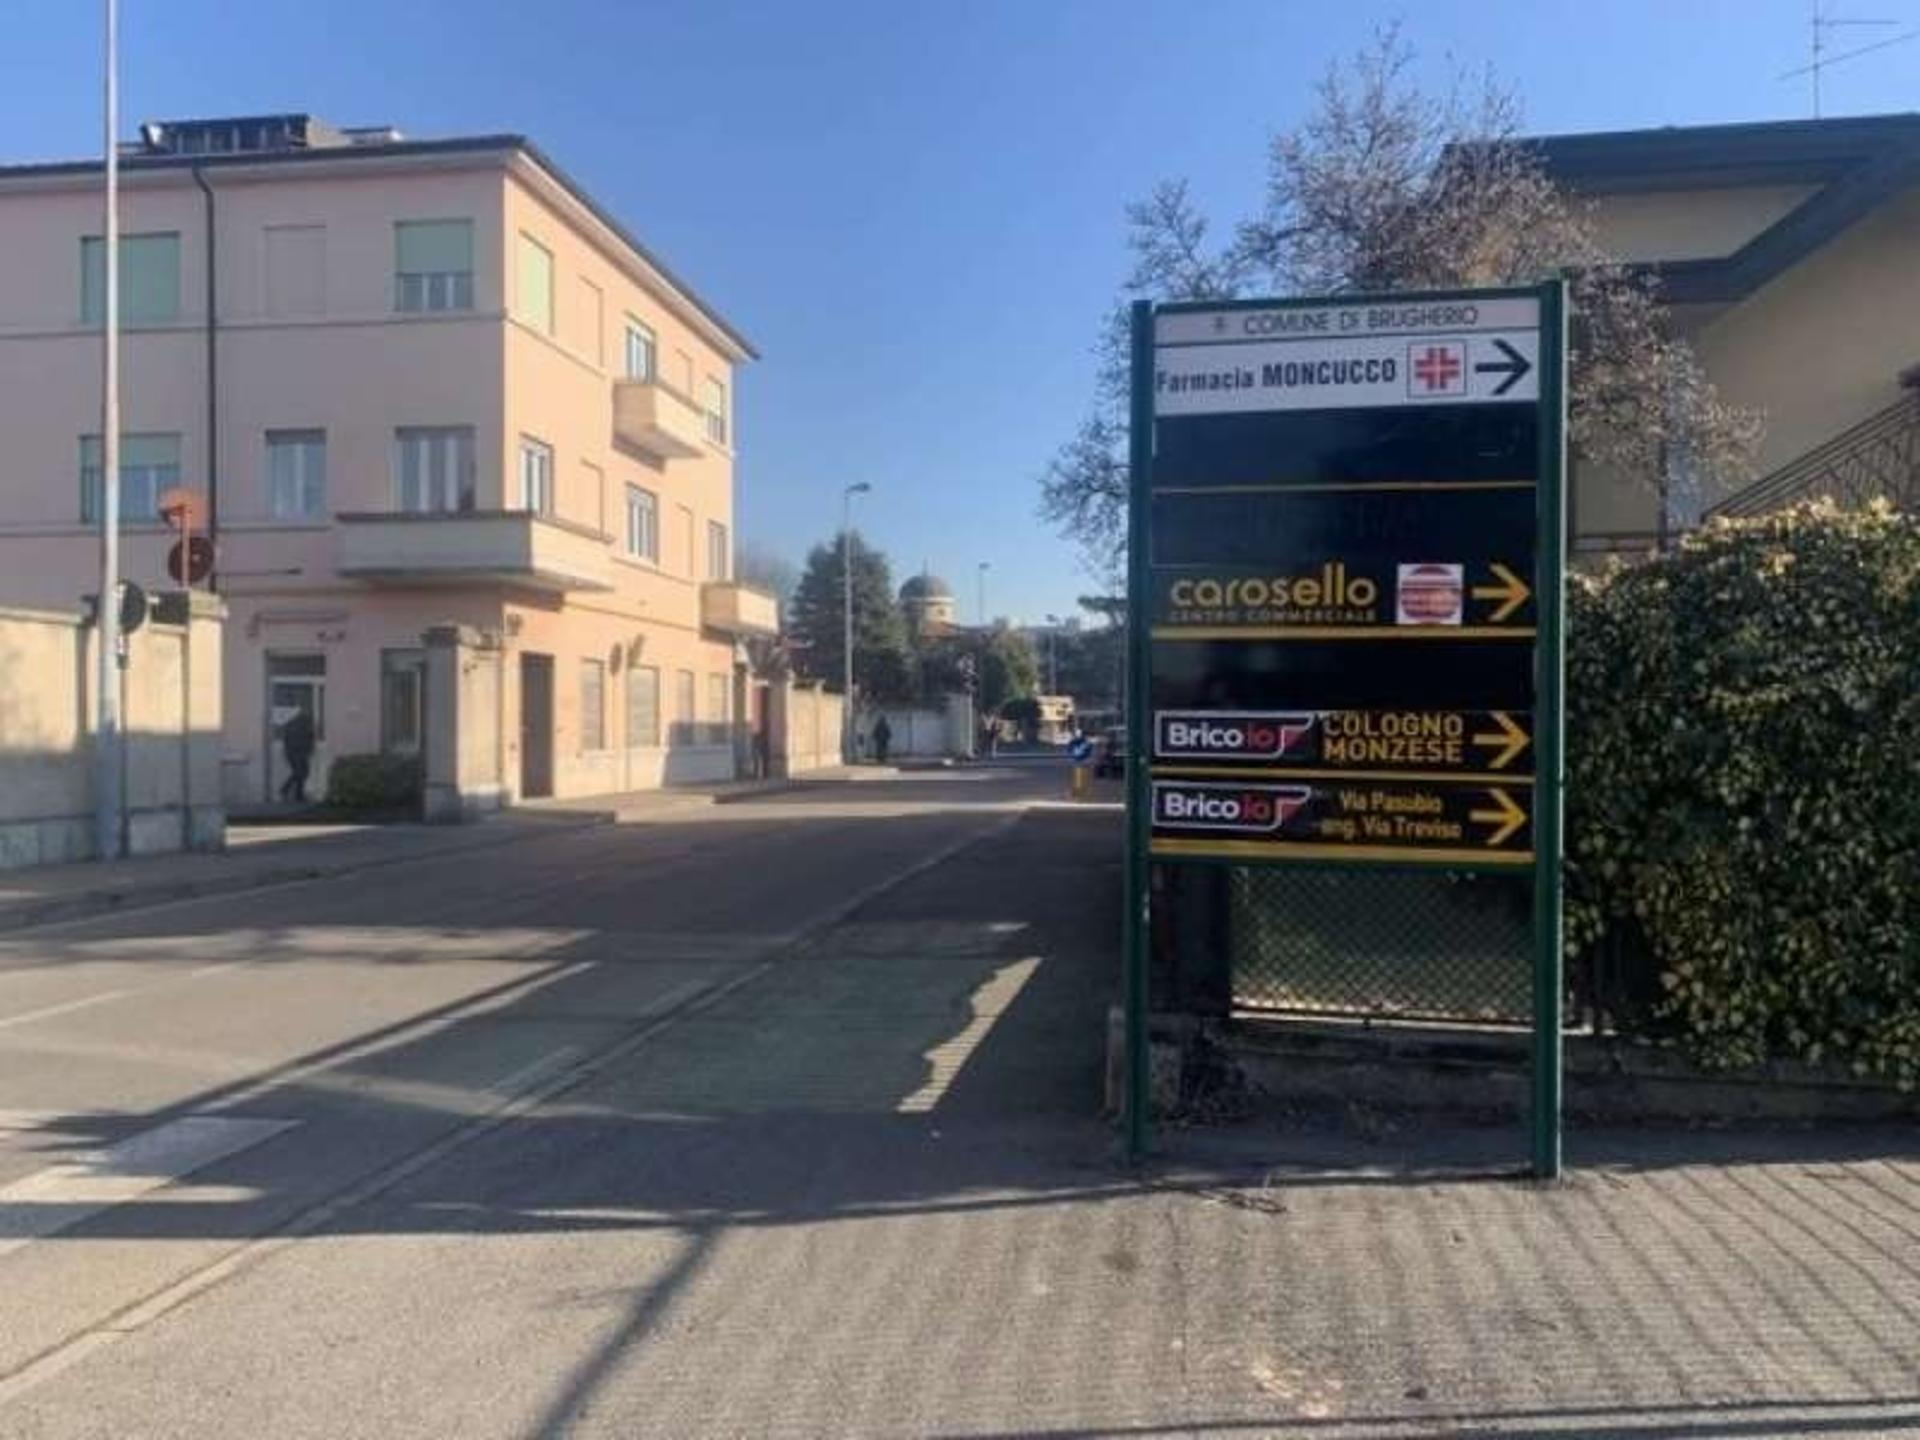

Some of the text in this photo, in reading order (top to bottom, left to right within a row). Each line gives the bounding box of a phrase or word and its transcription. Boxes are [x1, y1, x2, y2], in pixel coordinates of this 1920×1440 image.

[1243, 306, 1478, 335] COMUNE DI BRUGHERIO
[1156, 358, 1396, 393] Farmacia MONCUCCO
[1170, 563, 1377, 607] carosello
[1324, 712, 1464, 738] COLOGNO
[1324, 739, 1464, 763] MONZESE
